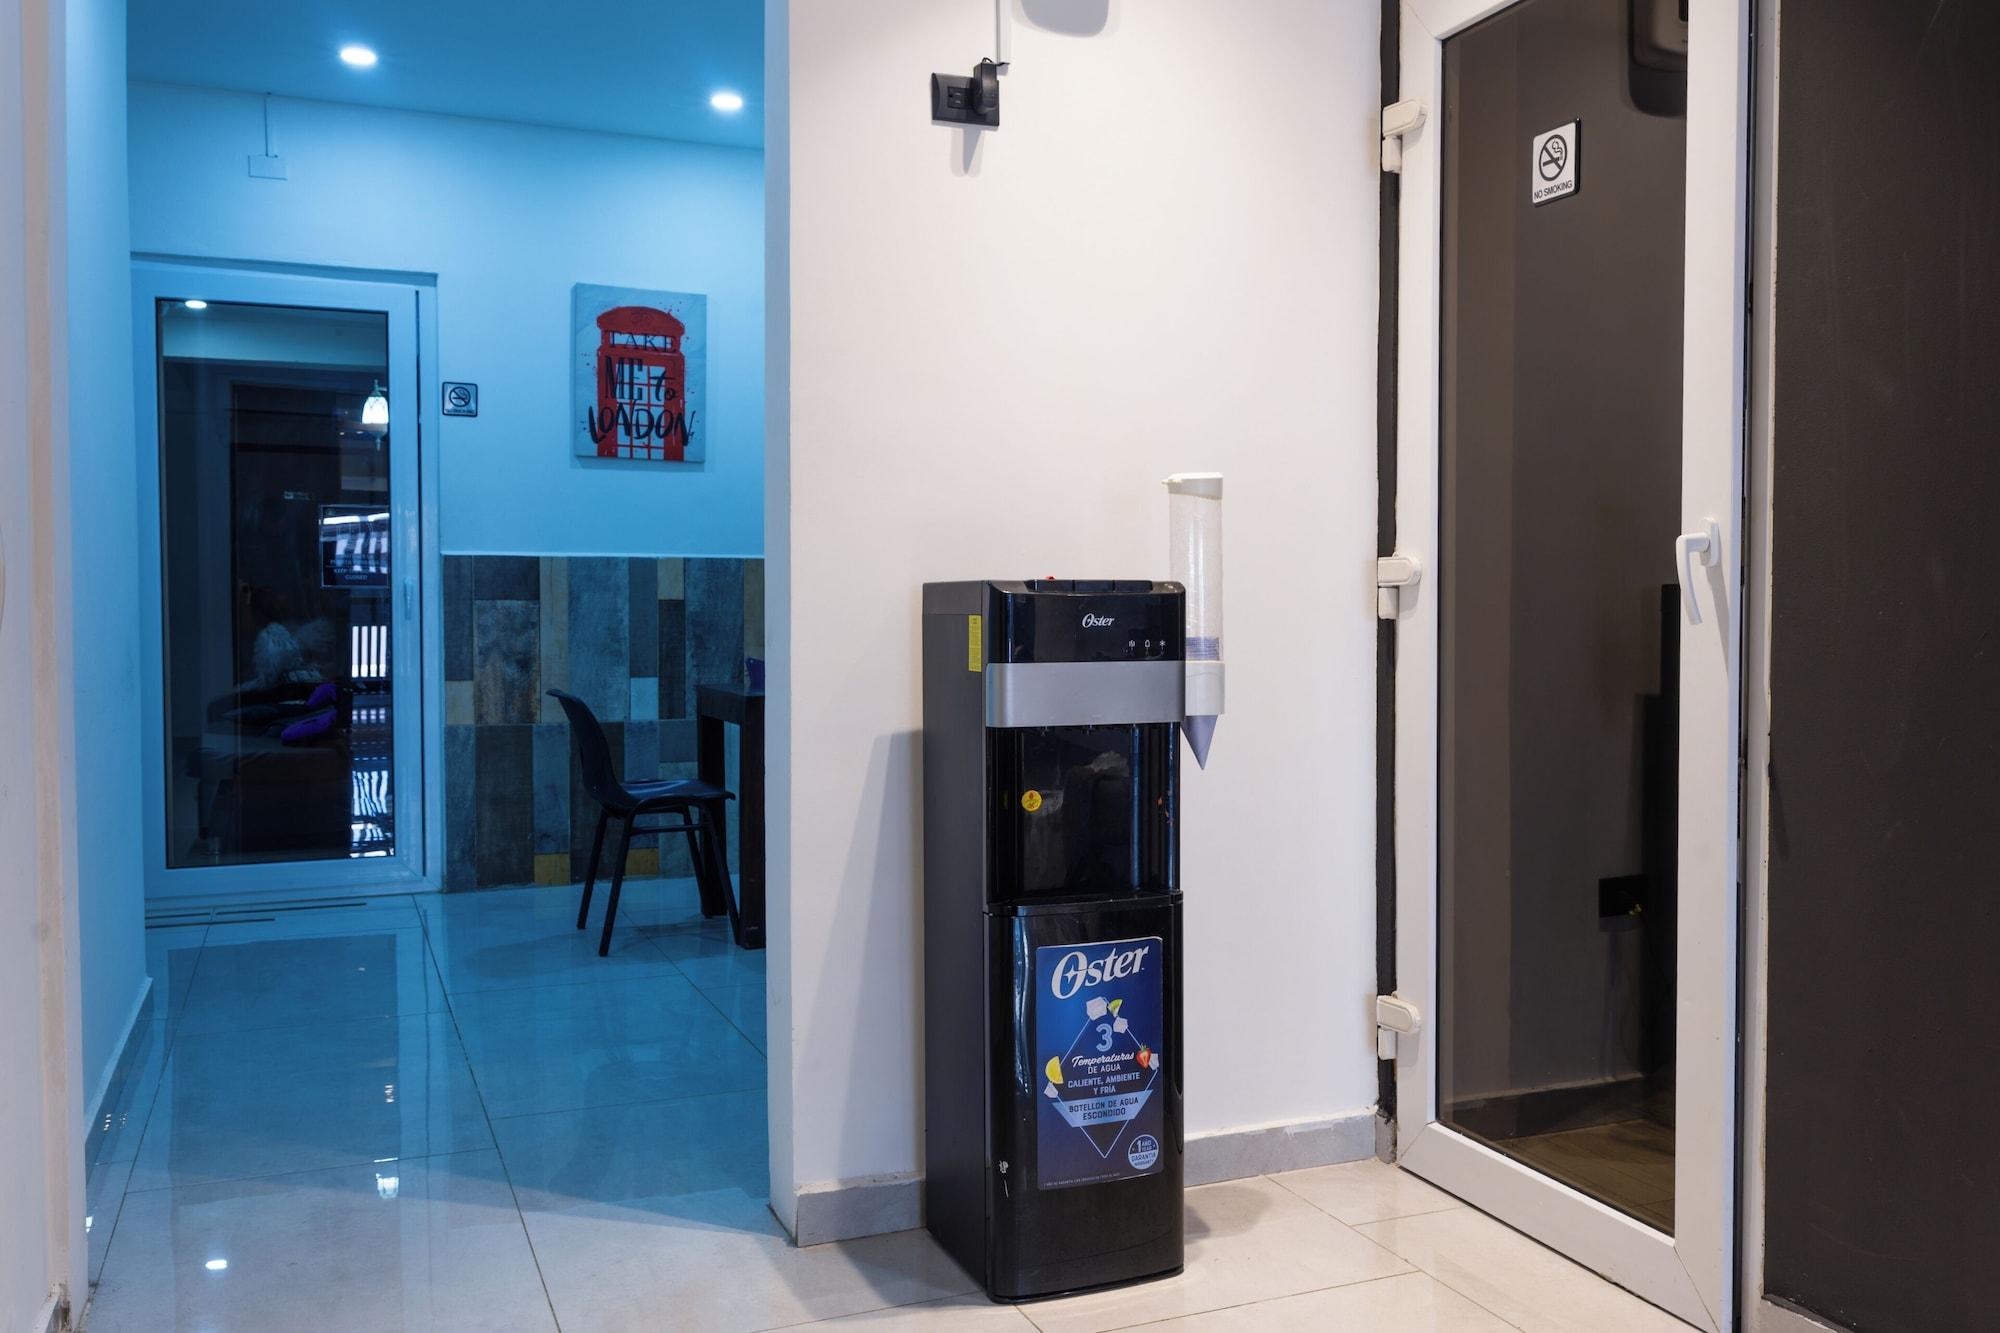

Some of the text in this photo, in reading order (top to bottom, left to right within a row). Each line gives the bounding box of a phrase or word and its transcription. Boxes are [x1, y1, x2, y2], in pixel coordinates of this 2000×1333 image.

[1534, 180, 1572, 200] NO SMOKING
[610, 331, 677, 353] TAKE
[604, 356, 678, 401] ME to
[588, 399, 696, 447] LONDON
[1081, 613, 1115, 628] Oster
[1051, 945, 1149, 1000] Oster
[1095, 1023, 1113, 1052] 3
[1071, 1052, 1135, 1068] Temperaturas
[1087, 1063, 1121, 1075] DE AGUA
[1105, 1071, 1141, 1084] AMBIENTE
[1093, 1087, 1098, 1096] Y
[1108, 1100, 1117, 1108] DE
[1119, 1096, 1139, 1107] AGUA
[1082, 1107, 1126, 1121] ESCONDIDO
[1137, 1140, 1142, 1152] 1
